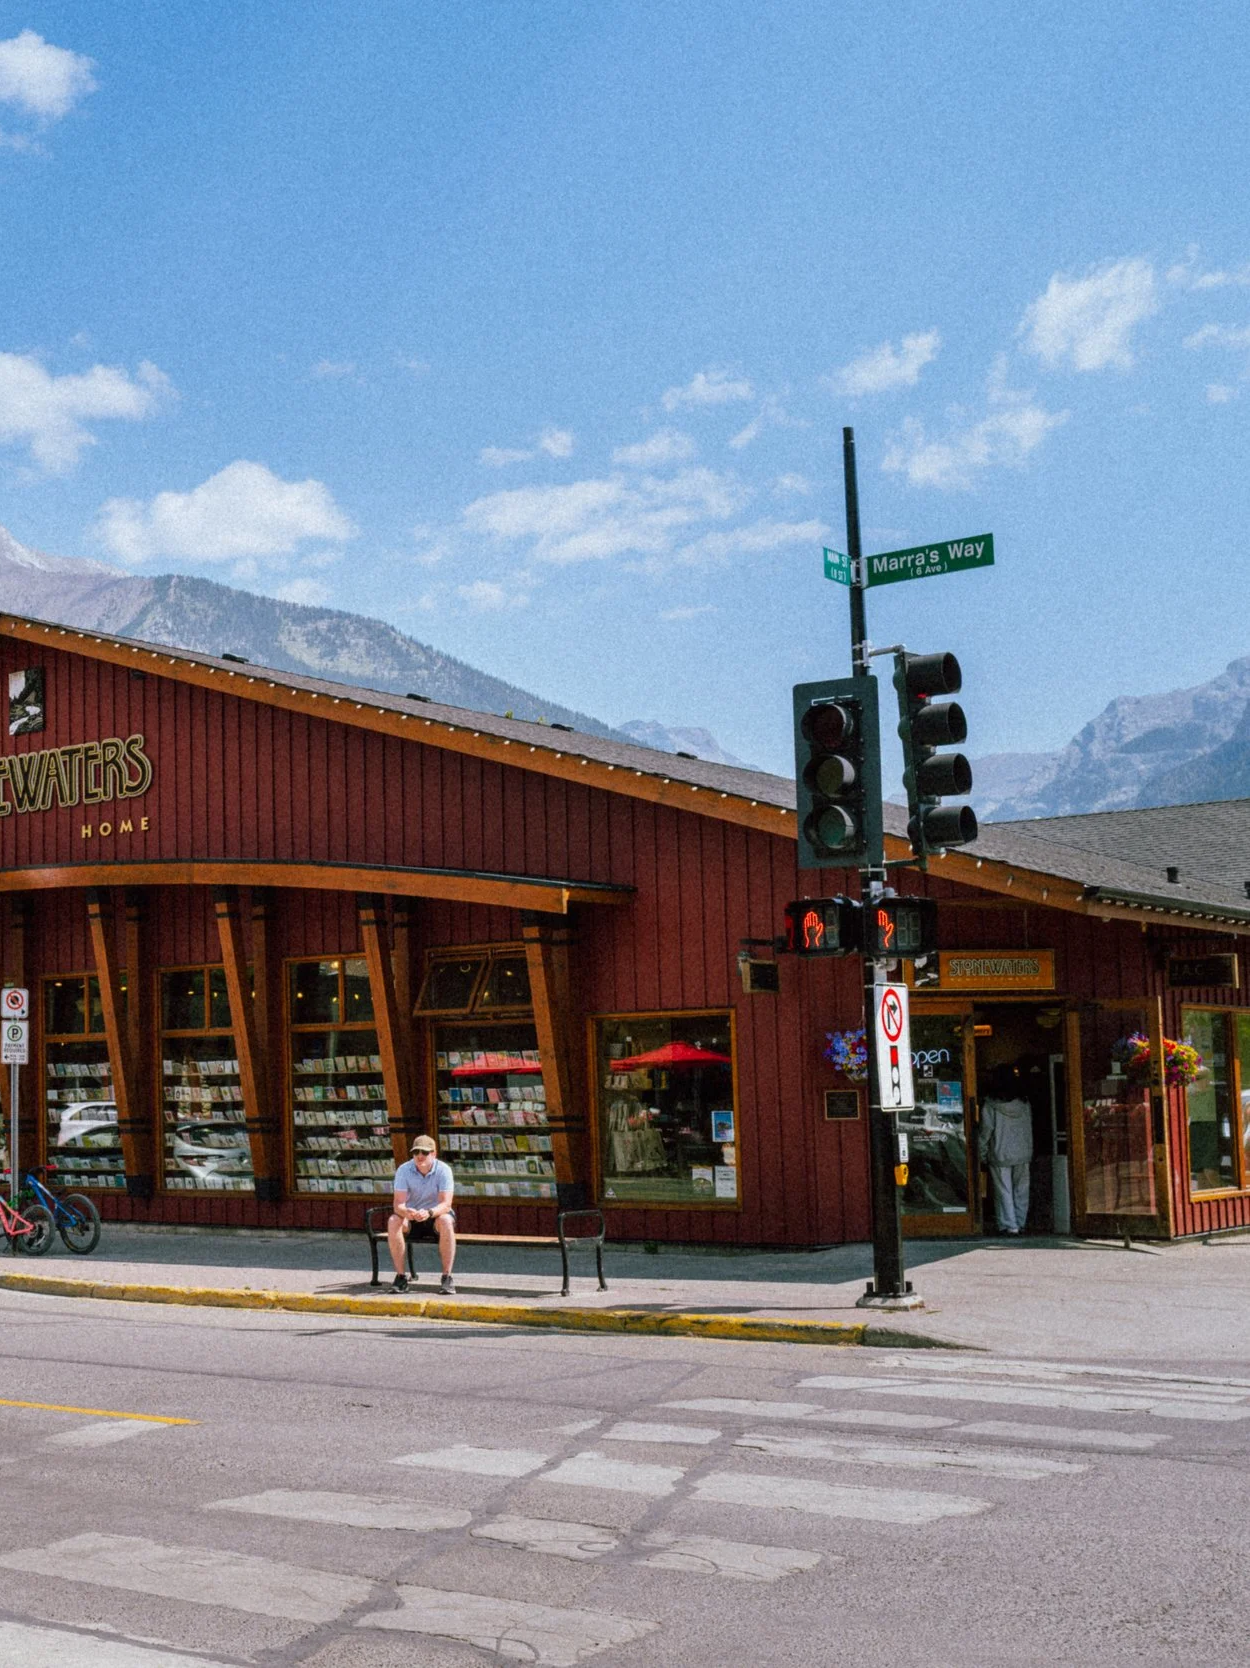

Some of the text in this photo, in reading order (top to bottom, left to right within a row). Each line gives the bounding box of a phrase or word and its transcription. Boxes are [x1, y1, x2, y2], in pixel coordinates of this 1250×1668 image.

[873, 541, 985, 574] Marra's Way
[81, 817, 150, 839] HOME
[950, 958, 1040, 976] STONEWATERS
